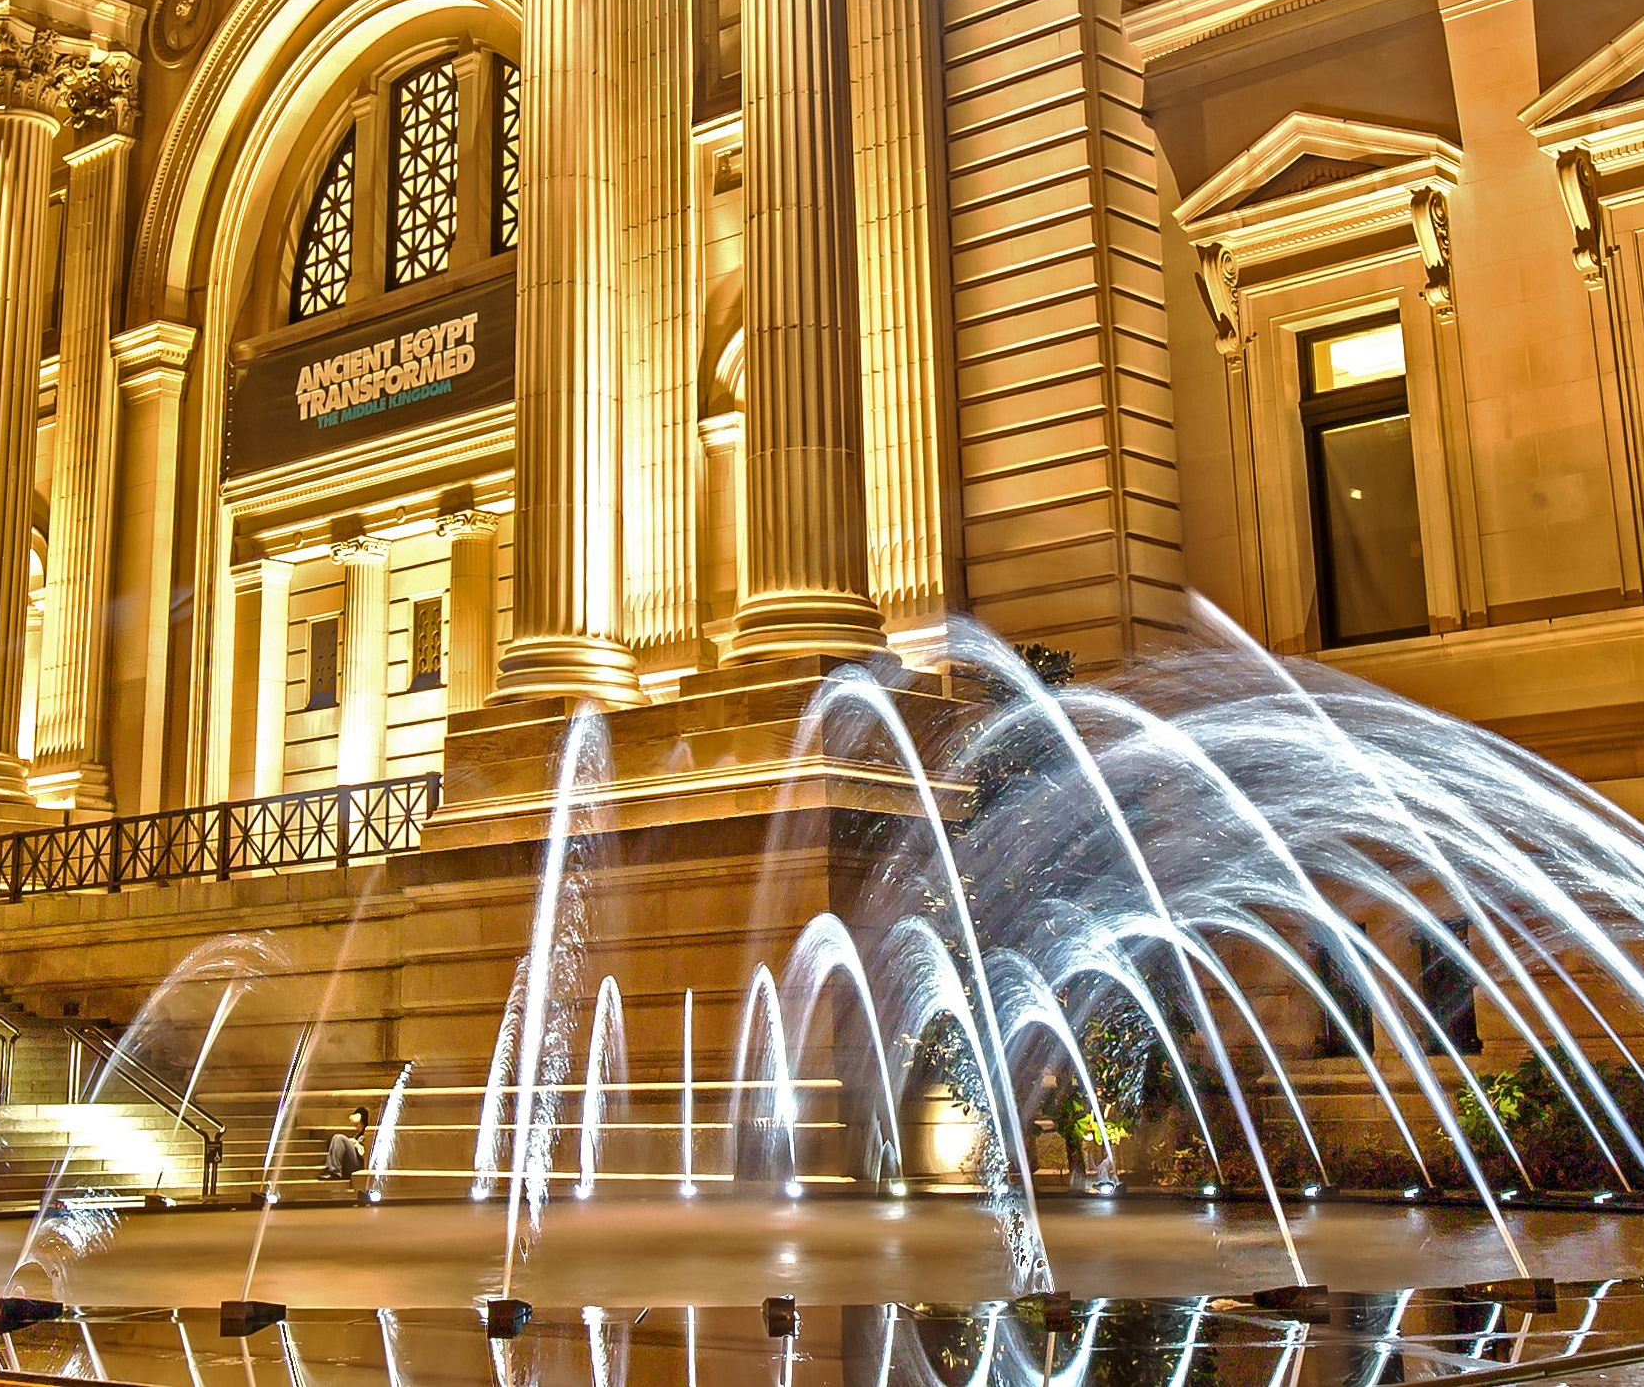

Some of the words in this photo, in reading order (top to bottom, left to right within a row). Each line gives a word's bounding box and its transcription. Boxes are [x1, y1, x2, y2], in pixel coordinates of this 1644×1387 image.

[295, 339, 396, 395] ANCIENT
[400, 312, 479, 363] EGYPT
[297, 344, 476, 421] TRANSFORMED
[317, 411, 338, 429] THE
[341, 397, 386, 422] MIDDLE
[388, 379, 452, 409] KINGDOM
